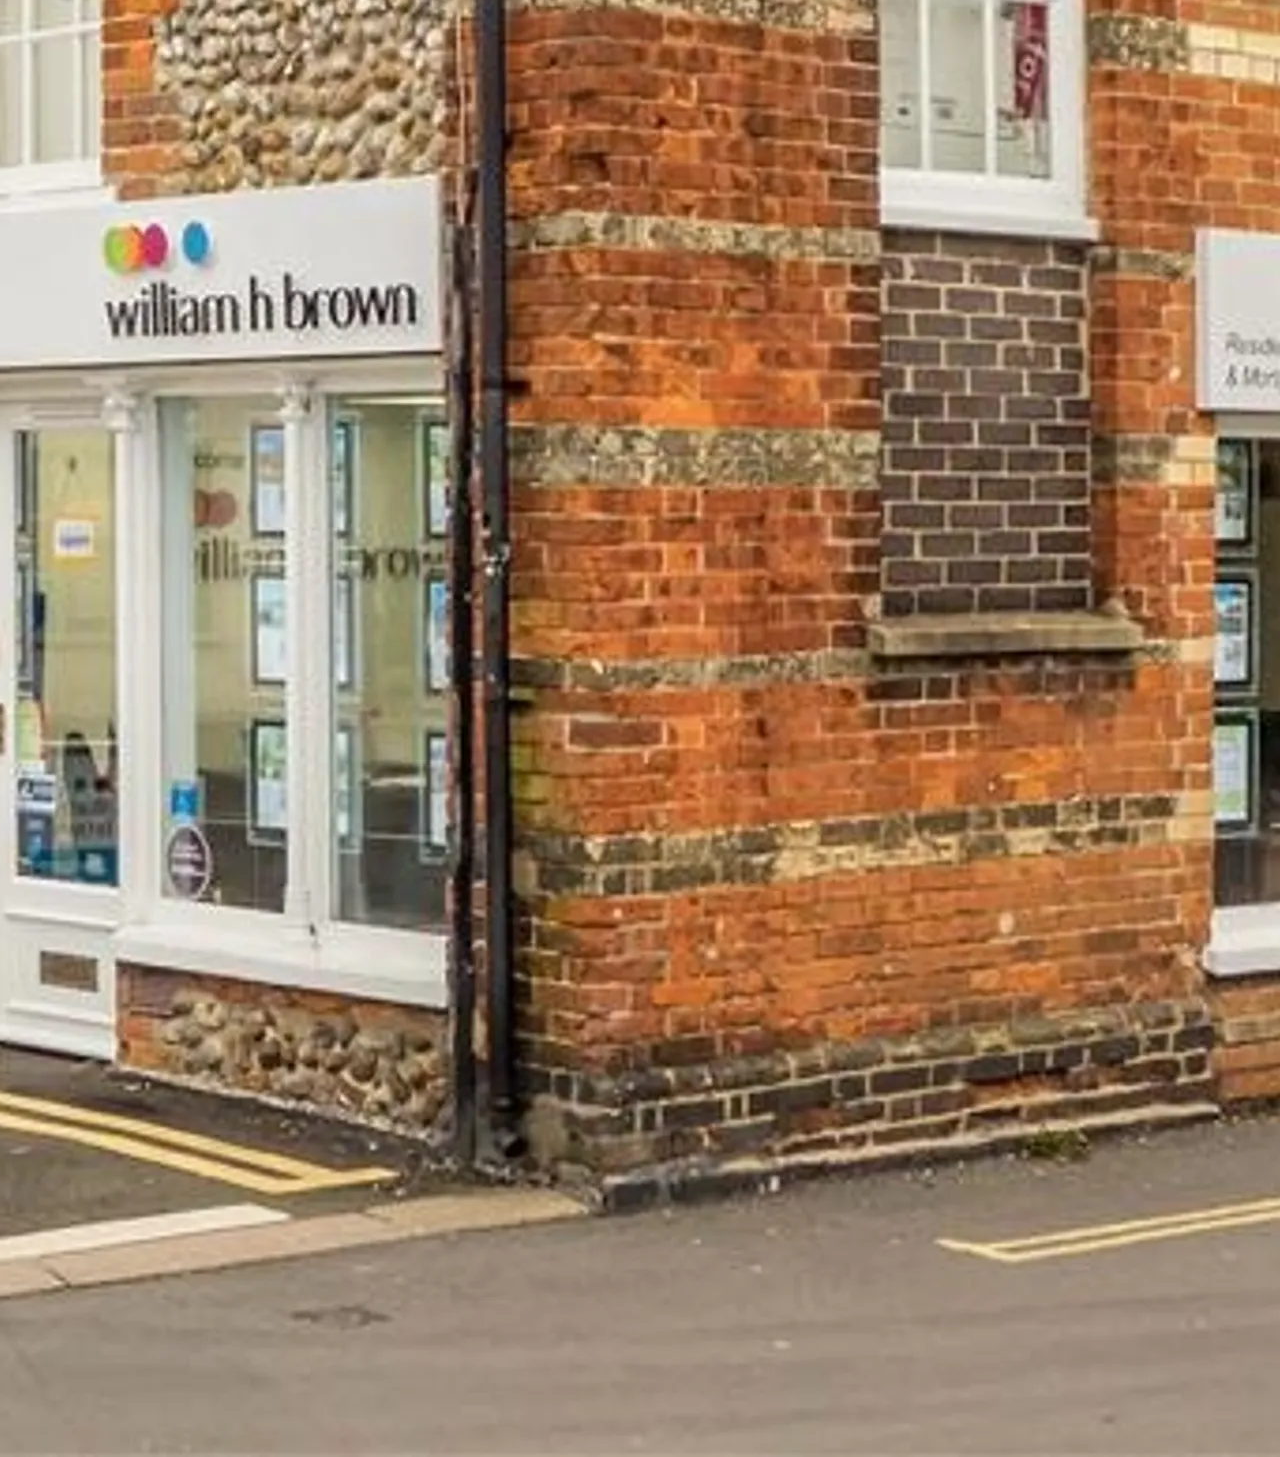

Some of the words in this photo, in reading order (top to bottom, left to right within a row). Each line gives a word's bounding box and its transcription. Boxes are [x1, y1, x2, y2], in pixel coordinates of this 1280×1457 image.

[106, 281, 238, 338] william
[249, 276, 272, 331] h
[283, 273, 417, 329] brown
[1225, 367, 1240, 389] &
